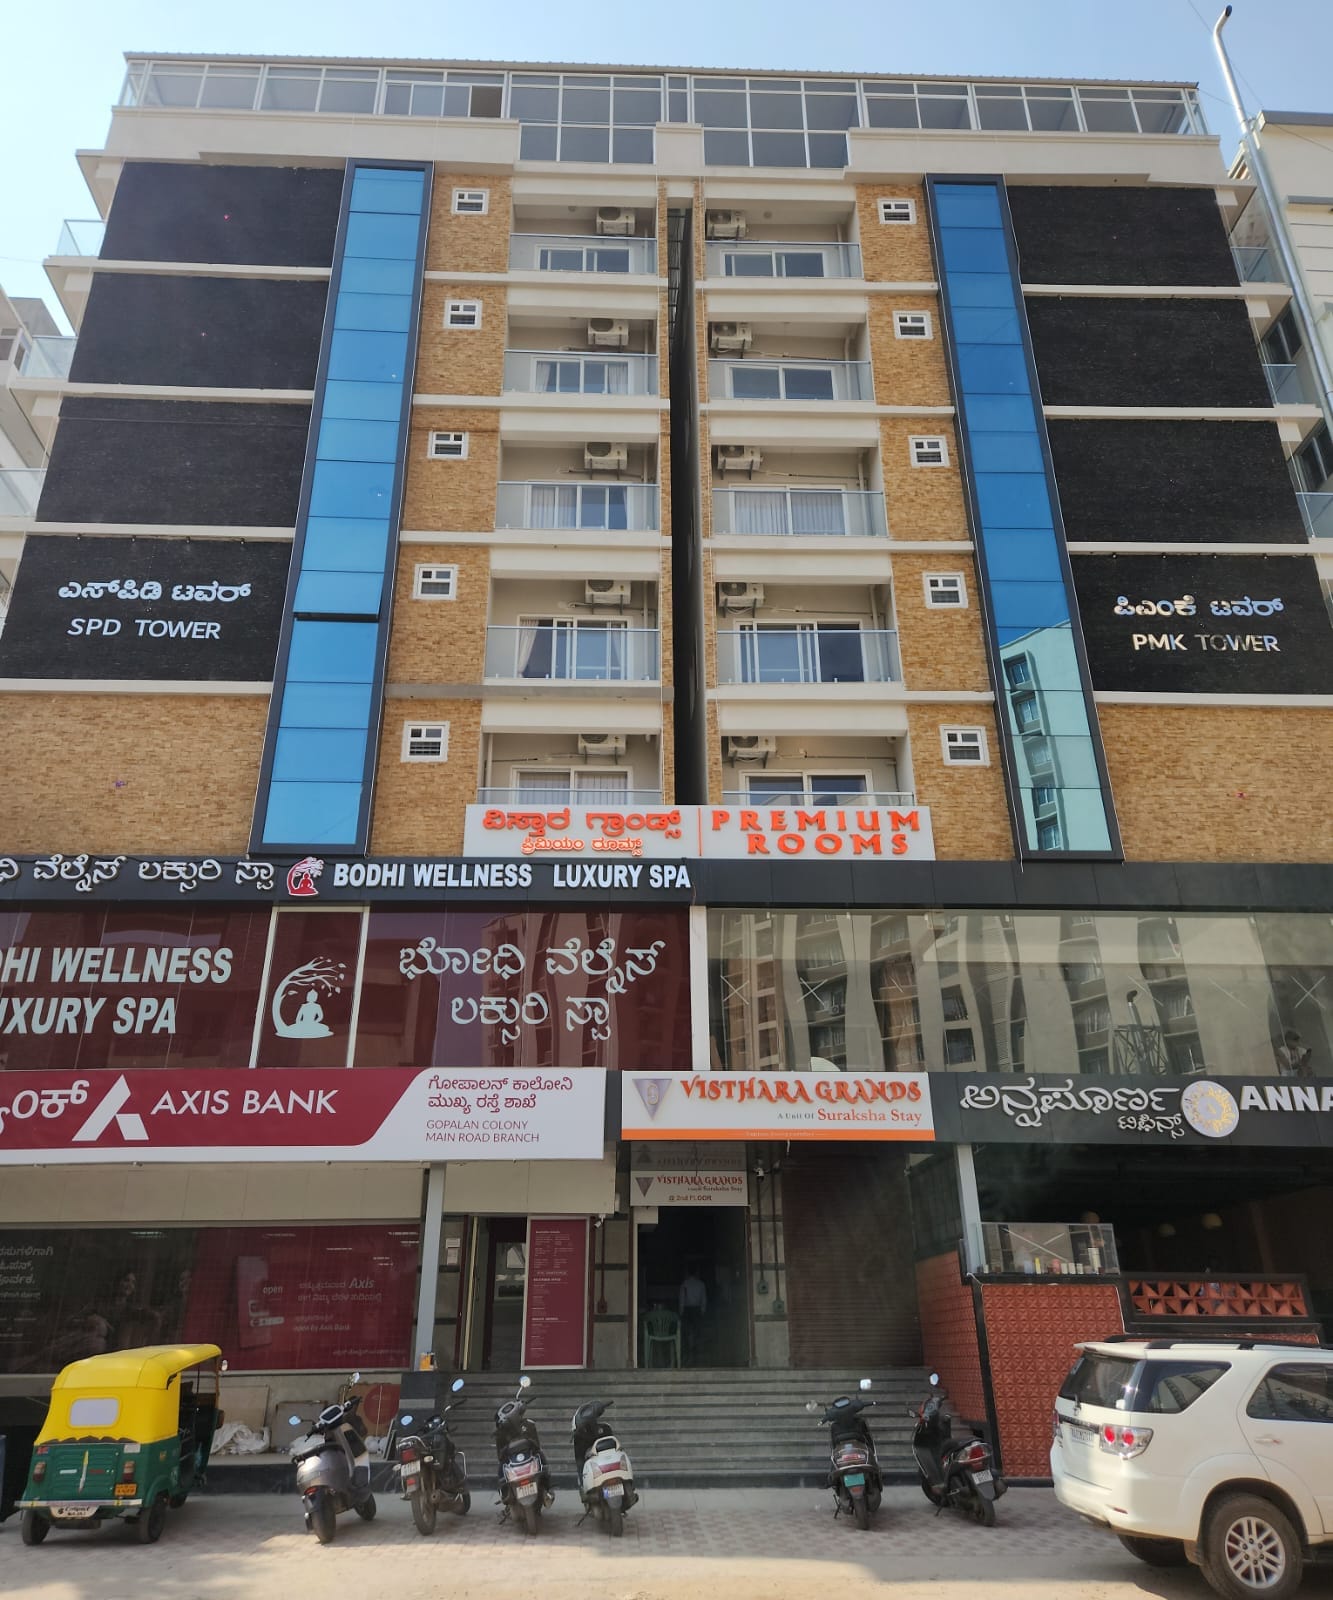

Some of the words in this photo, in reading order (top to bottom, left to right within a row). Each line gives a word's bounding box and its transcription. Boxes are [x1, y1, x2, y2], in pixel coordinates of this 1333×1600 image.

[171, 580, 252, 602] ಟವರ್
[1113, 594, 1198, 616] ಪಿಎಂಕೆ
[1210, 595, 1284, 617] ಟವರ್
[67, 618, 122, 636] SPD
[134, 619, 221, 640] TOWER
[1132, 633, 1188, 651] PMK
[1194, 633, 1281, 652] TOWER
[482, 807, 571, 837] ವಿಸ್ತಾರ
[585, 809, 682, 839] ಗ್ರಾಂಡ್ಸ್
[711, 809, 920, 831] PREMIUM
[747, 833, 910, 855] ROOMS
[235, 860, 275, 890] ಸ್ಪಾ
[333, 863, 405, 888] BODHI
[412, 863, 532, 888] WELLNESS
[553, 864, 644, 888] LUXURY
[649, 865, 692, 889] SPA
[0, 947, 42, 983] HI
[50, 947, 233, 984] WELLNESS
[0, 997, 107, 1035] XURY
[112, 997, 176, 1035] SPA
[565, 996, 611, 1041] ಸ್ಪಾ
[428, 1074, 508, 1091] ಗೋಪಾಲನ್
[512, 1076, 574, 1091] ಕಾಲೋನಿ
[680, 1075, 814, 1103] VISTHARA
[815, 1078, 923, 1103] GRANDS
[0, 1079, 90, 1135] ಂಕ್
[150, 1089, 230, 1115] AXIS
[242, 1089, 339, 1114] BANK
[428, 1094, 472, 1115] ಮುಖ್ಯ
[476, 1094, 501, 1114] ರಸ್ತೆ
[504, 1094, 537, 1110] ಶಾಖೆ
[959, 1077, 1180, 1127] ಅನ್ನಪೂರ್ಣ
[426, 1120, 479, 1130] GOPALAN
[482, 1120, 529, 1131] COLONY
[786, 1112, 804, 1121] Unit
[817, 1108, 887, 1122] Suraksha
[890, 1108, 922, 1126] Stay
[425, 1132, 456, 1142] MAIN
[458, 1132, 490, 1143] ROAD
[493, 1133, 540, 1143] BRANCH
[657, 1174, 705, 1186] VISTHARA
[705, 1175, 743, 1186] GRANDS
[262, 1286, 283, 1295] open
[348, 1276, 375, 1289] Axis
